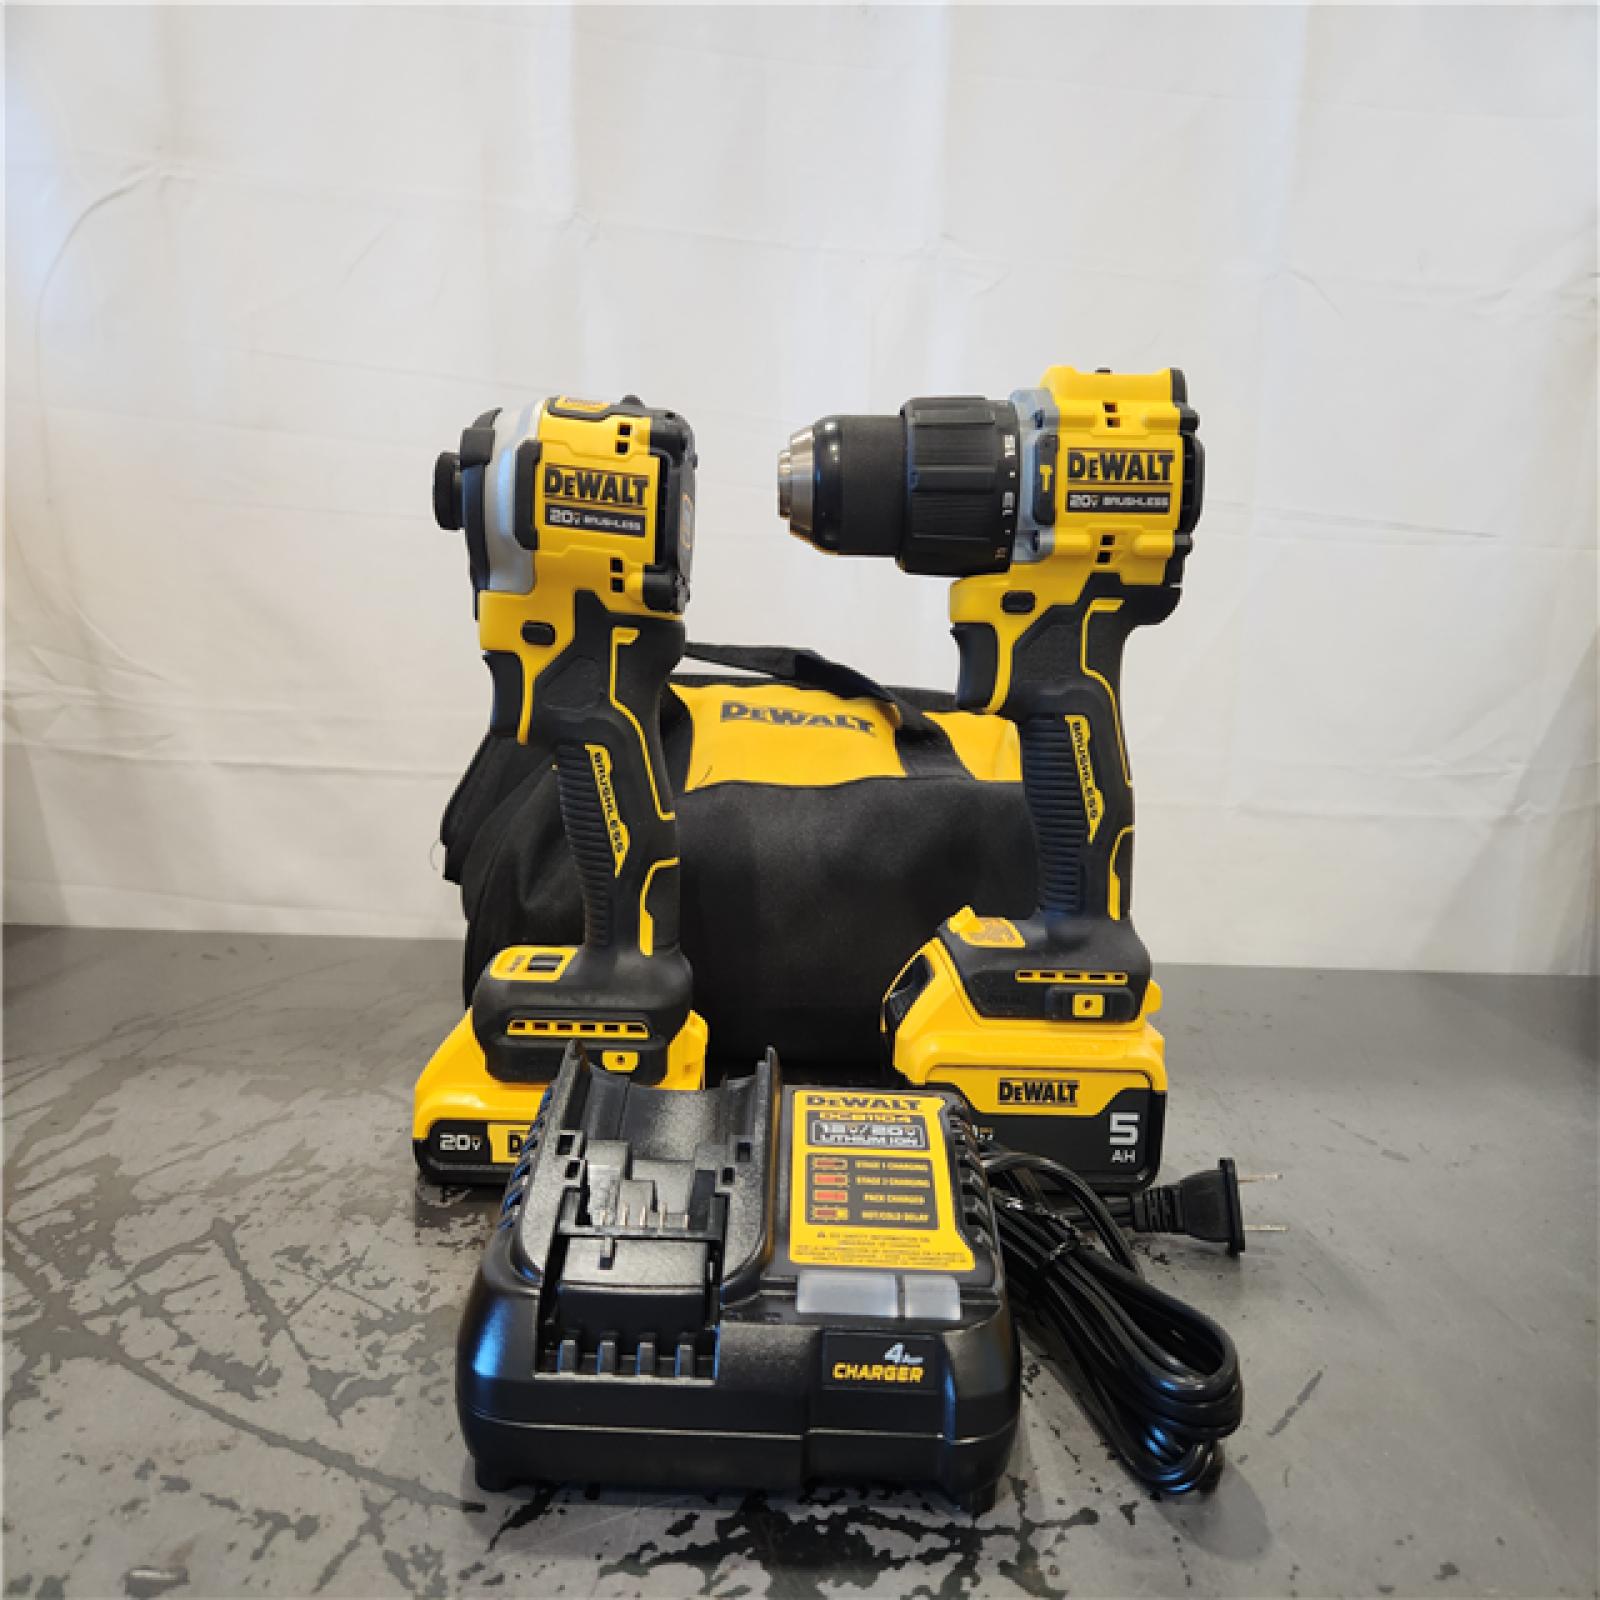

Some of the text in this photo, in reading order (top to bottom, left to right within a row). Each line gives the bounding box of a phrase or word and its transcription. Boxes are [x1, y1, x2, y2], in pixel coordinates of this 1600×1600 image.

[1108, 1112, 1140, 1146] 5
[1111, 1149, 1136, 1164] AH
[832, 1362, 925, 1383] CHARGER
